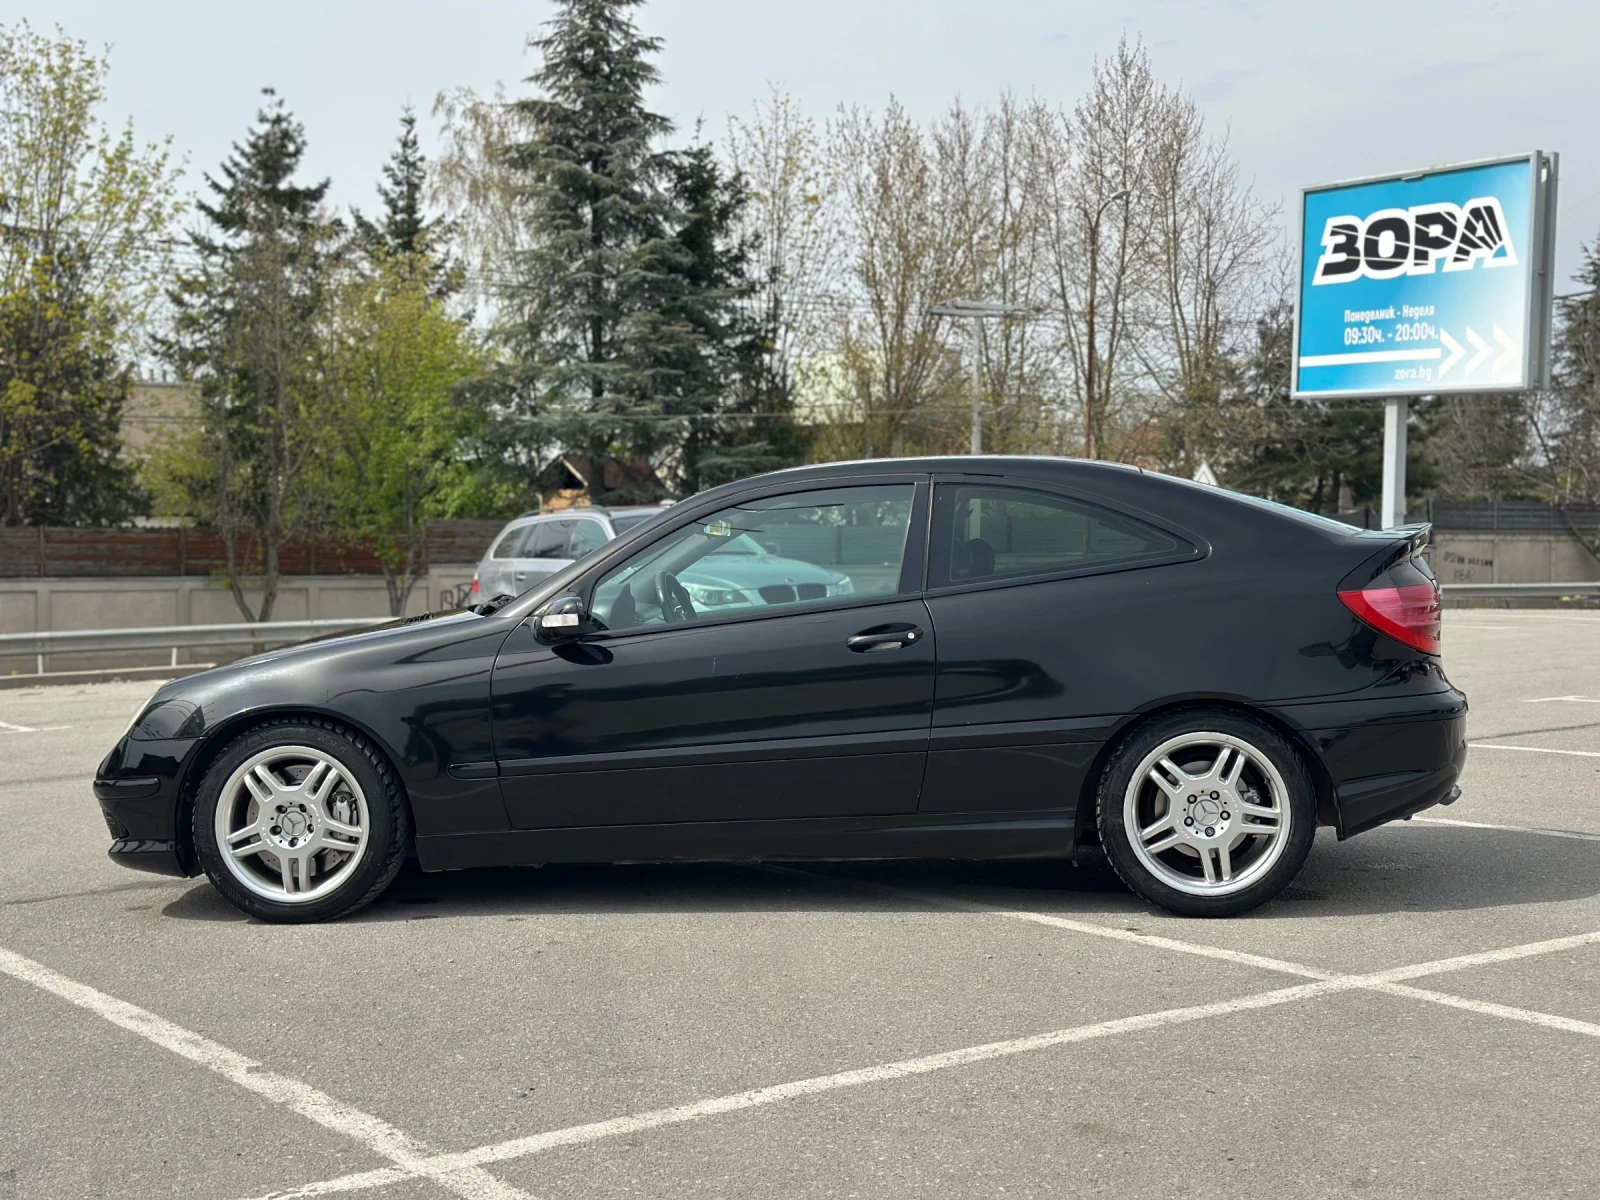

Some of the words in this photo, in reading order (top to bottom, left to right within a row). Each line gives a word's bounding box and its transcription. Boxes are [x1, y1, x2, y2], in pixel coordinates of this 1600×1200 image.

[1314, 198, 1516, 284] ЗОРА
[1344, 306, 1395, 323] Понеделник
[1402, 304, 1435, 320] Неделя
[1344, 326, 1385, 345] 09:30ч.
[1395, 322, 1438, 341] 20:00ч.
[1394, 366, 1432, 382] zora.bg
